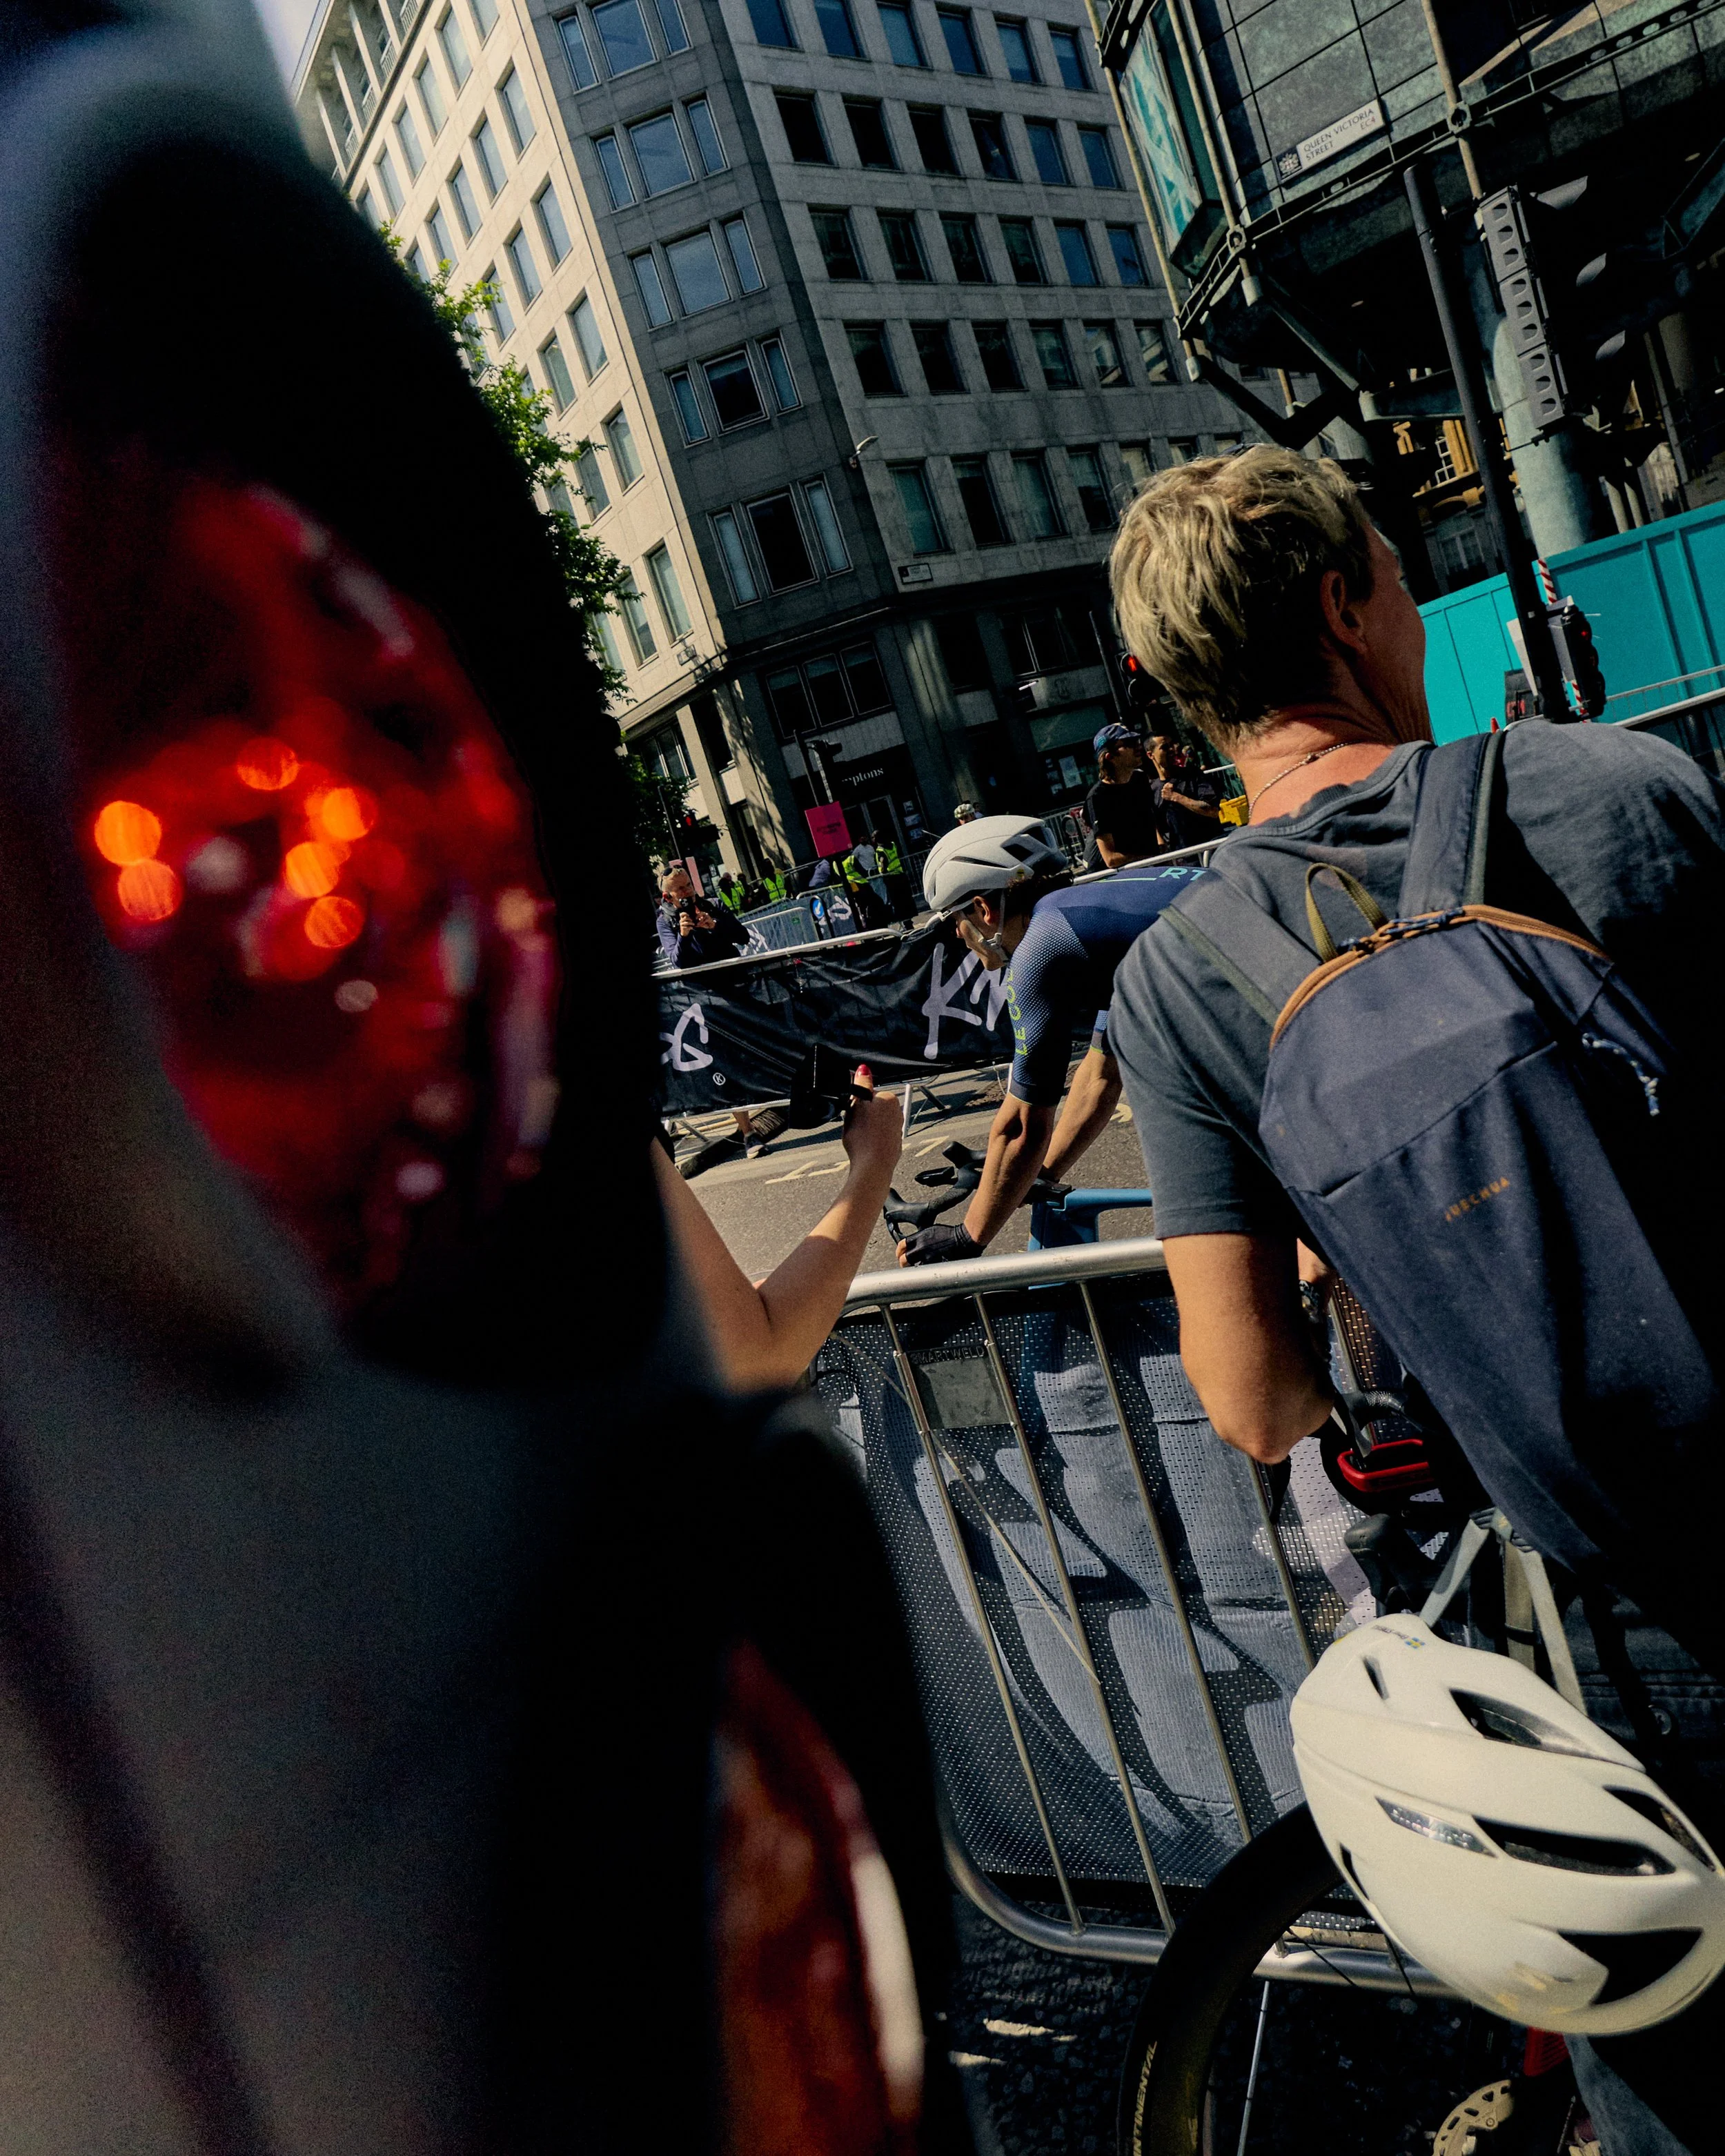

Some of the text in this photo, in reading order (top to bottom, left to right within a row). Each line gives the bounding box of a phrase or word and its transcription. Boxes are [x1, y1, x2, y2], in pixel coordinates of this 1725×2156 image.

[1303, 108, 1374, 152] QUEEN VICTORIA
[1360, 116, 1376, 130] EC4
[1305, 141, 1334, 161] STREET
[1015, 1027, 1028, 1056] LE
[910, 1345, 985, 1365] SMARTWELD
[1133, 2040, 1158, 2156] NTINENTAL
